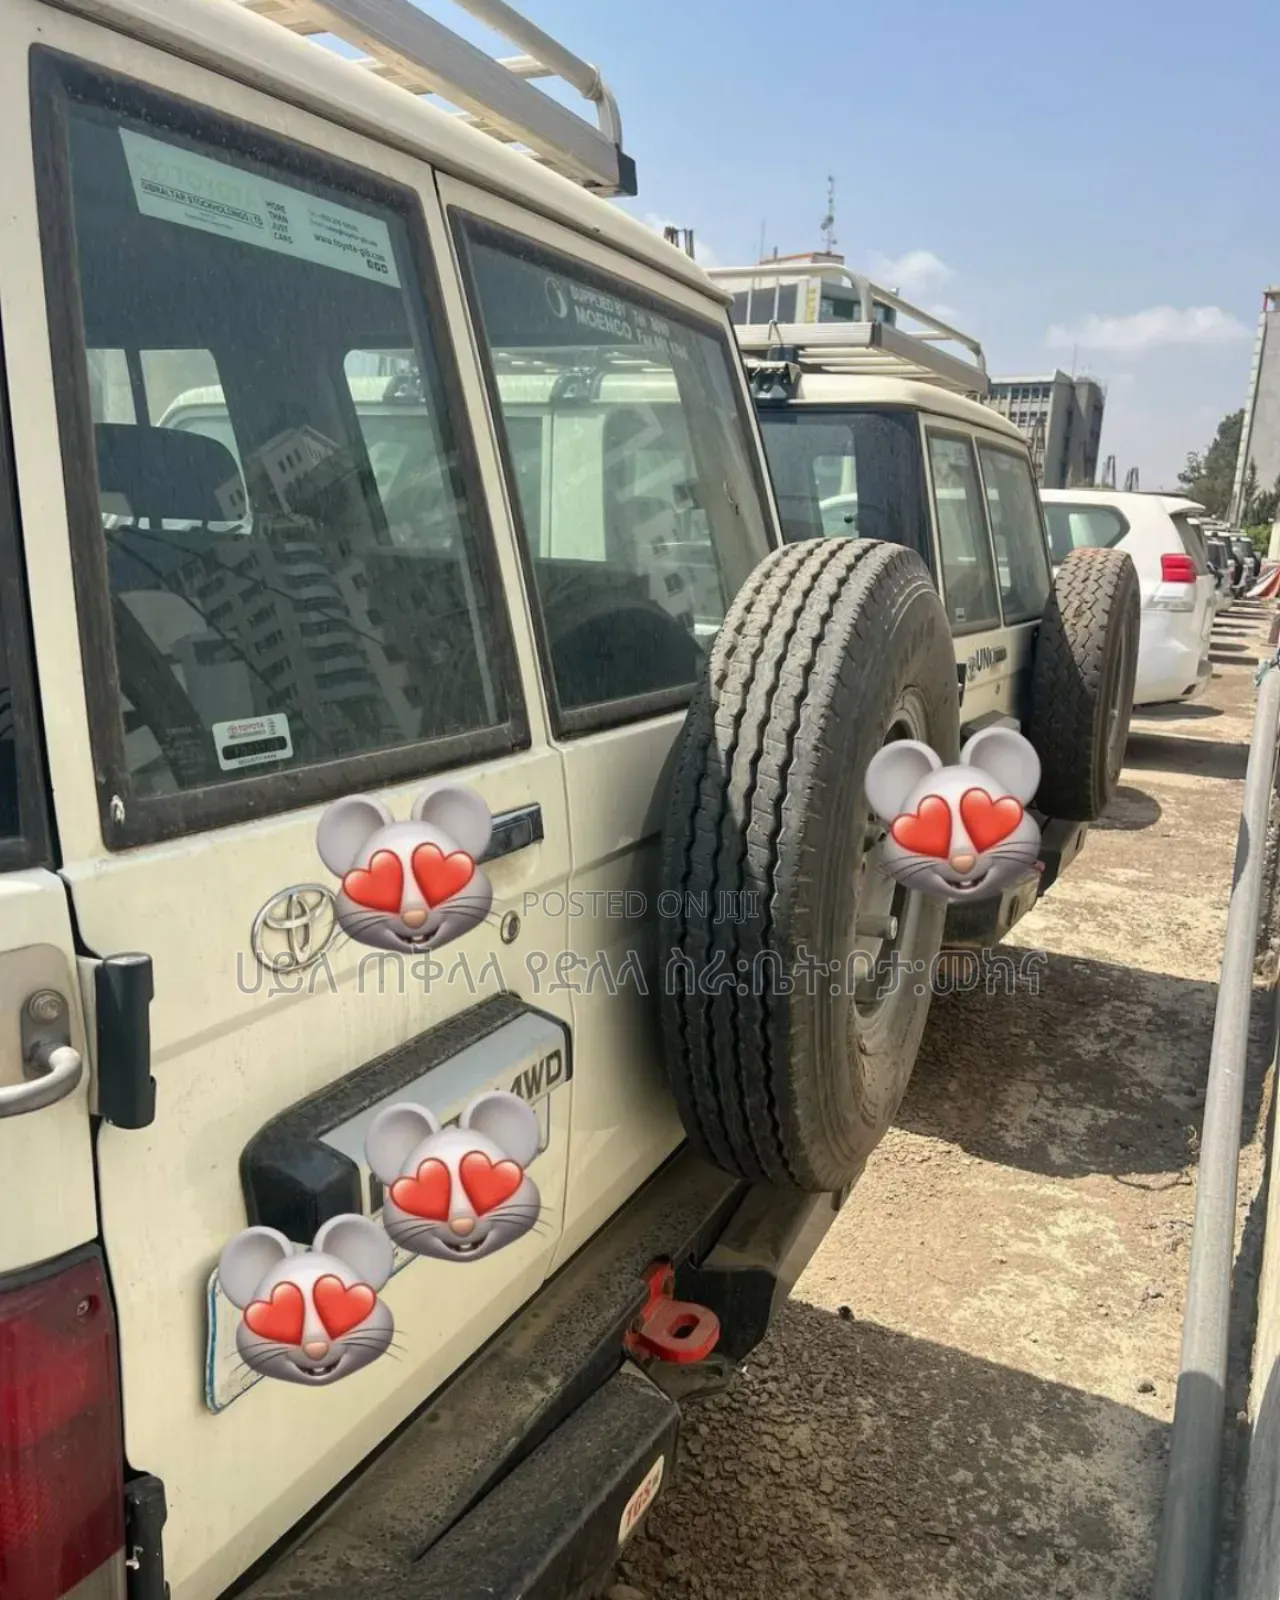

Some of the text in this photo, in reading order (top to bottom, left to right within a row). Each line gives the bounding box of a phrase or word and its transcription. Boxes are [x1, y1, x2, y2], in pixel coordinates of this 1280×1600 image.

[141, 181, 186, 204] GIBRALTAR
[265, 200, 286, 213] MORE
[268, 210, 289, 224] THAN
[272, 222, 289, 233] JUST
[274, 231, 294, 245] CARS
[574, 305, 632, 340] MOENCO
